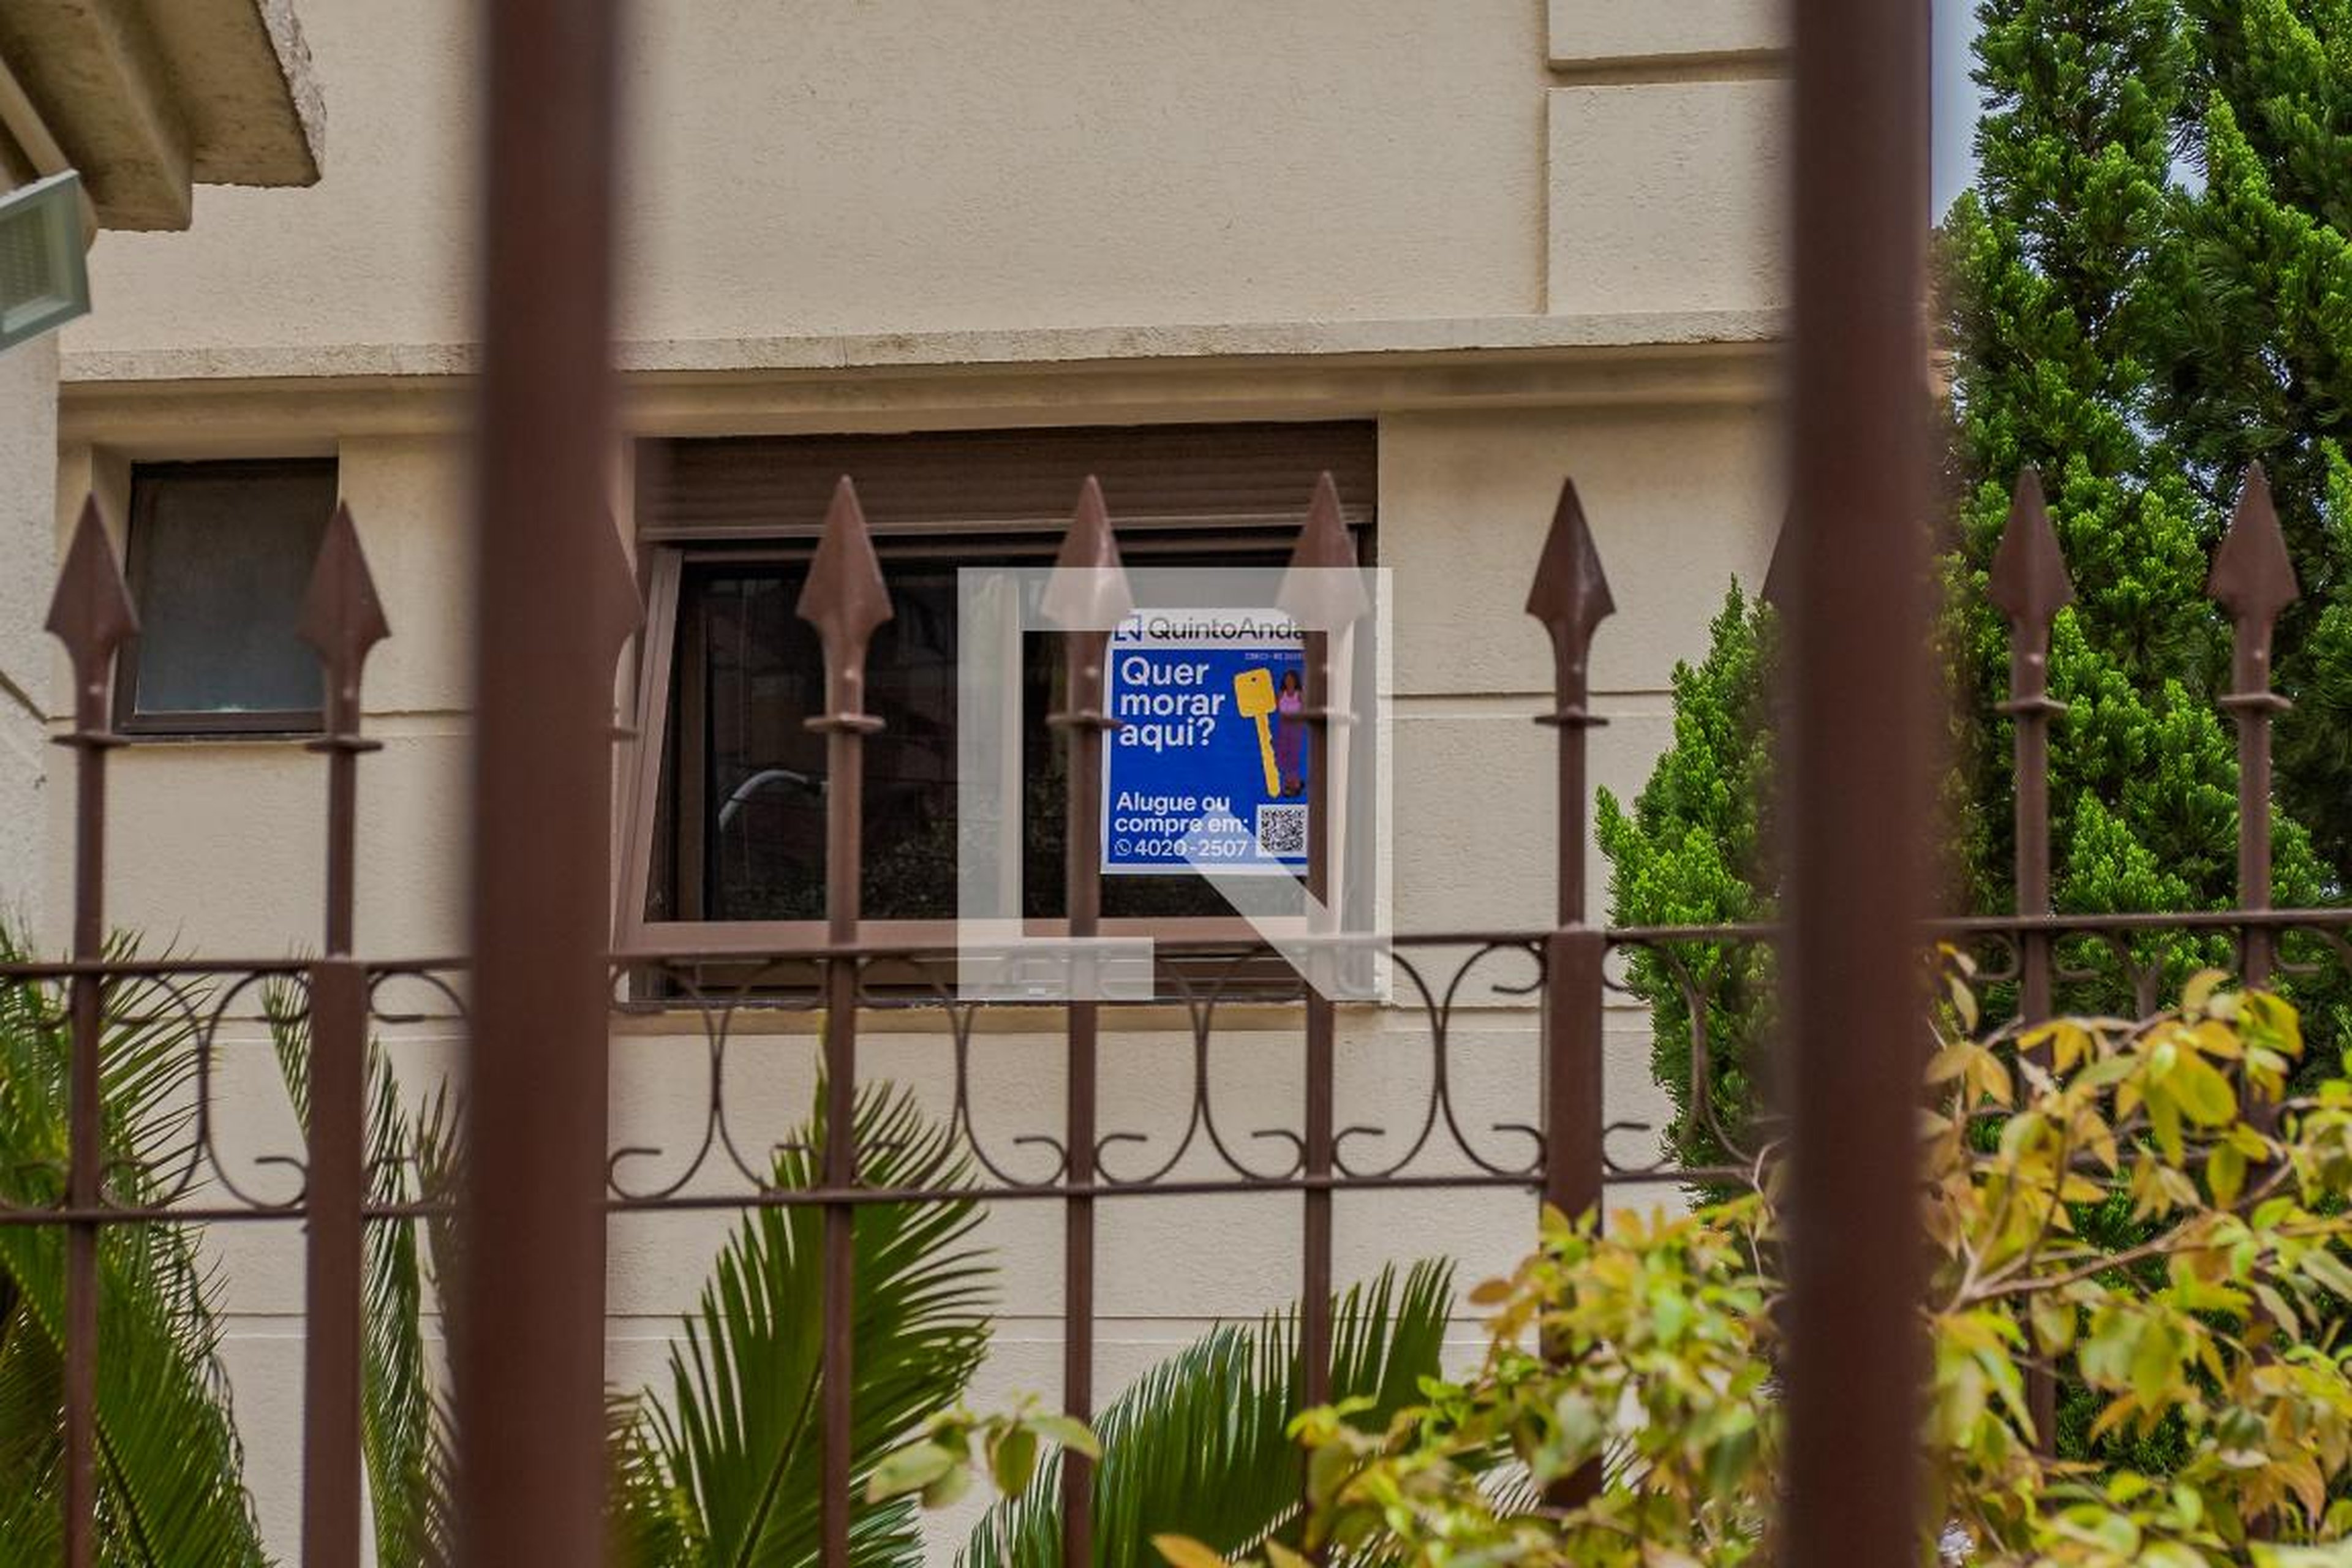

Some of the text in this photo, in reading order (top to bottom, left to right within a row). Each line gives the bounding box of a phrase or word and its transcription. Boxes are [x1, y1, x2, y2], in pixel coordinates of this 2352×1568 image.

[1148, 617, 1306, 640] QuintoAnda
[1121, 656, 1210, 686] Quer
[1120, 693, 1226, 716] morar
[1119, 717, 1216, 753] aqui?
[1116, 791, 1230, 816] Alugue ou
[1114, 817, 1249, 837] compre em:
